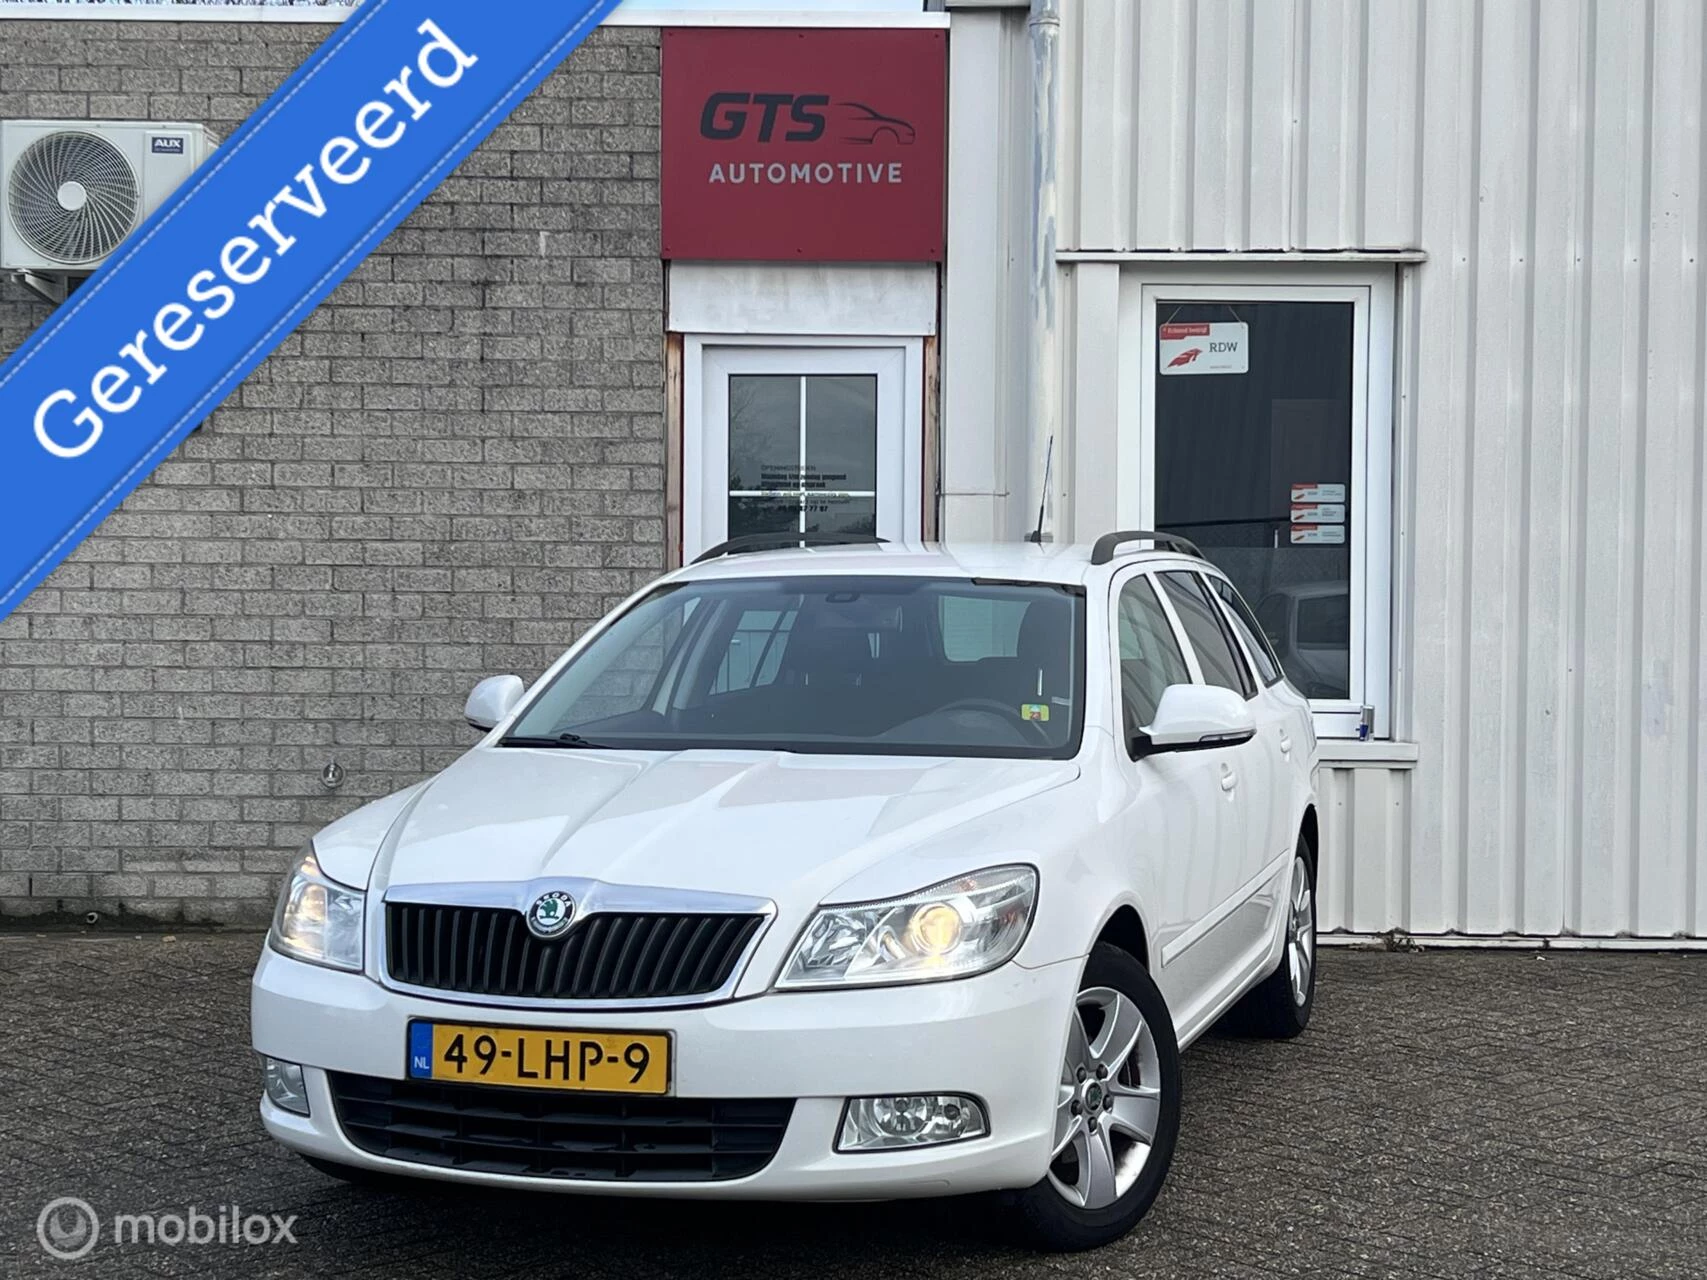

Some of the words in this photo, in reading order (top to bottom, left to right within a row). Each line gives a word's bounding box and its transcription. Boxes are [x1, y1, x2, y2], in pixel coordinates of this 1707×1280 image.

[700, 92, 830, 143] GTS
[154, 139, 181, 148] AUX
[708, 163, 903, 184] AUTOMOTIVE
[1209, 342, 1239, 353] RDW
[413, 1056, 430, 1070] NL
[444, 1033, 650, 1084] 49-LHP-9
